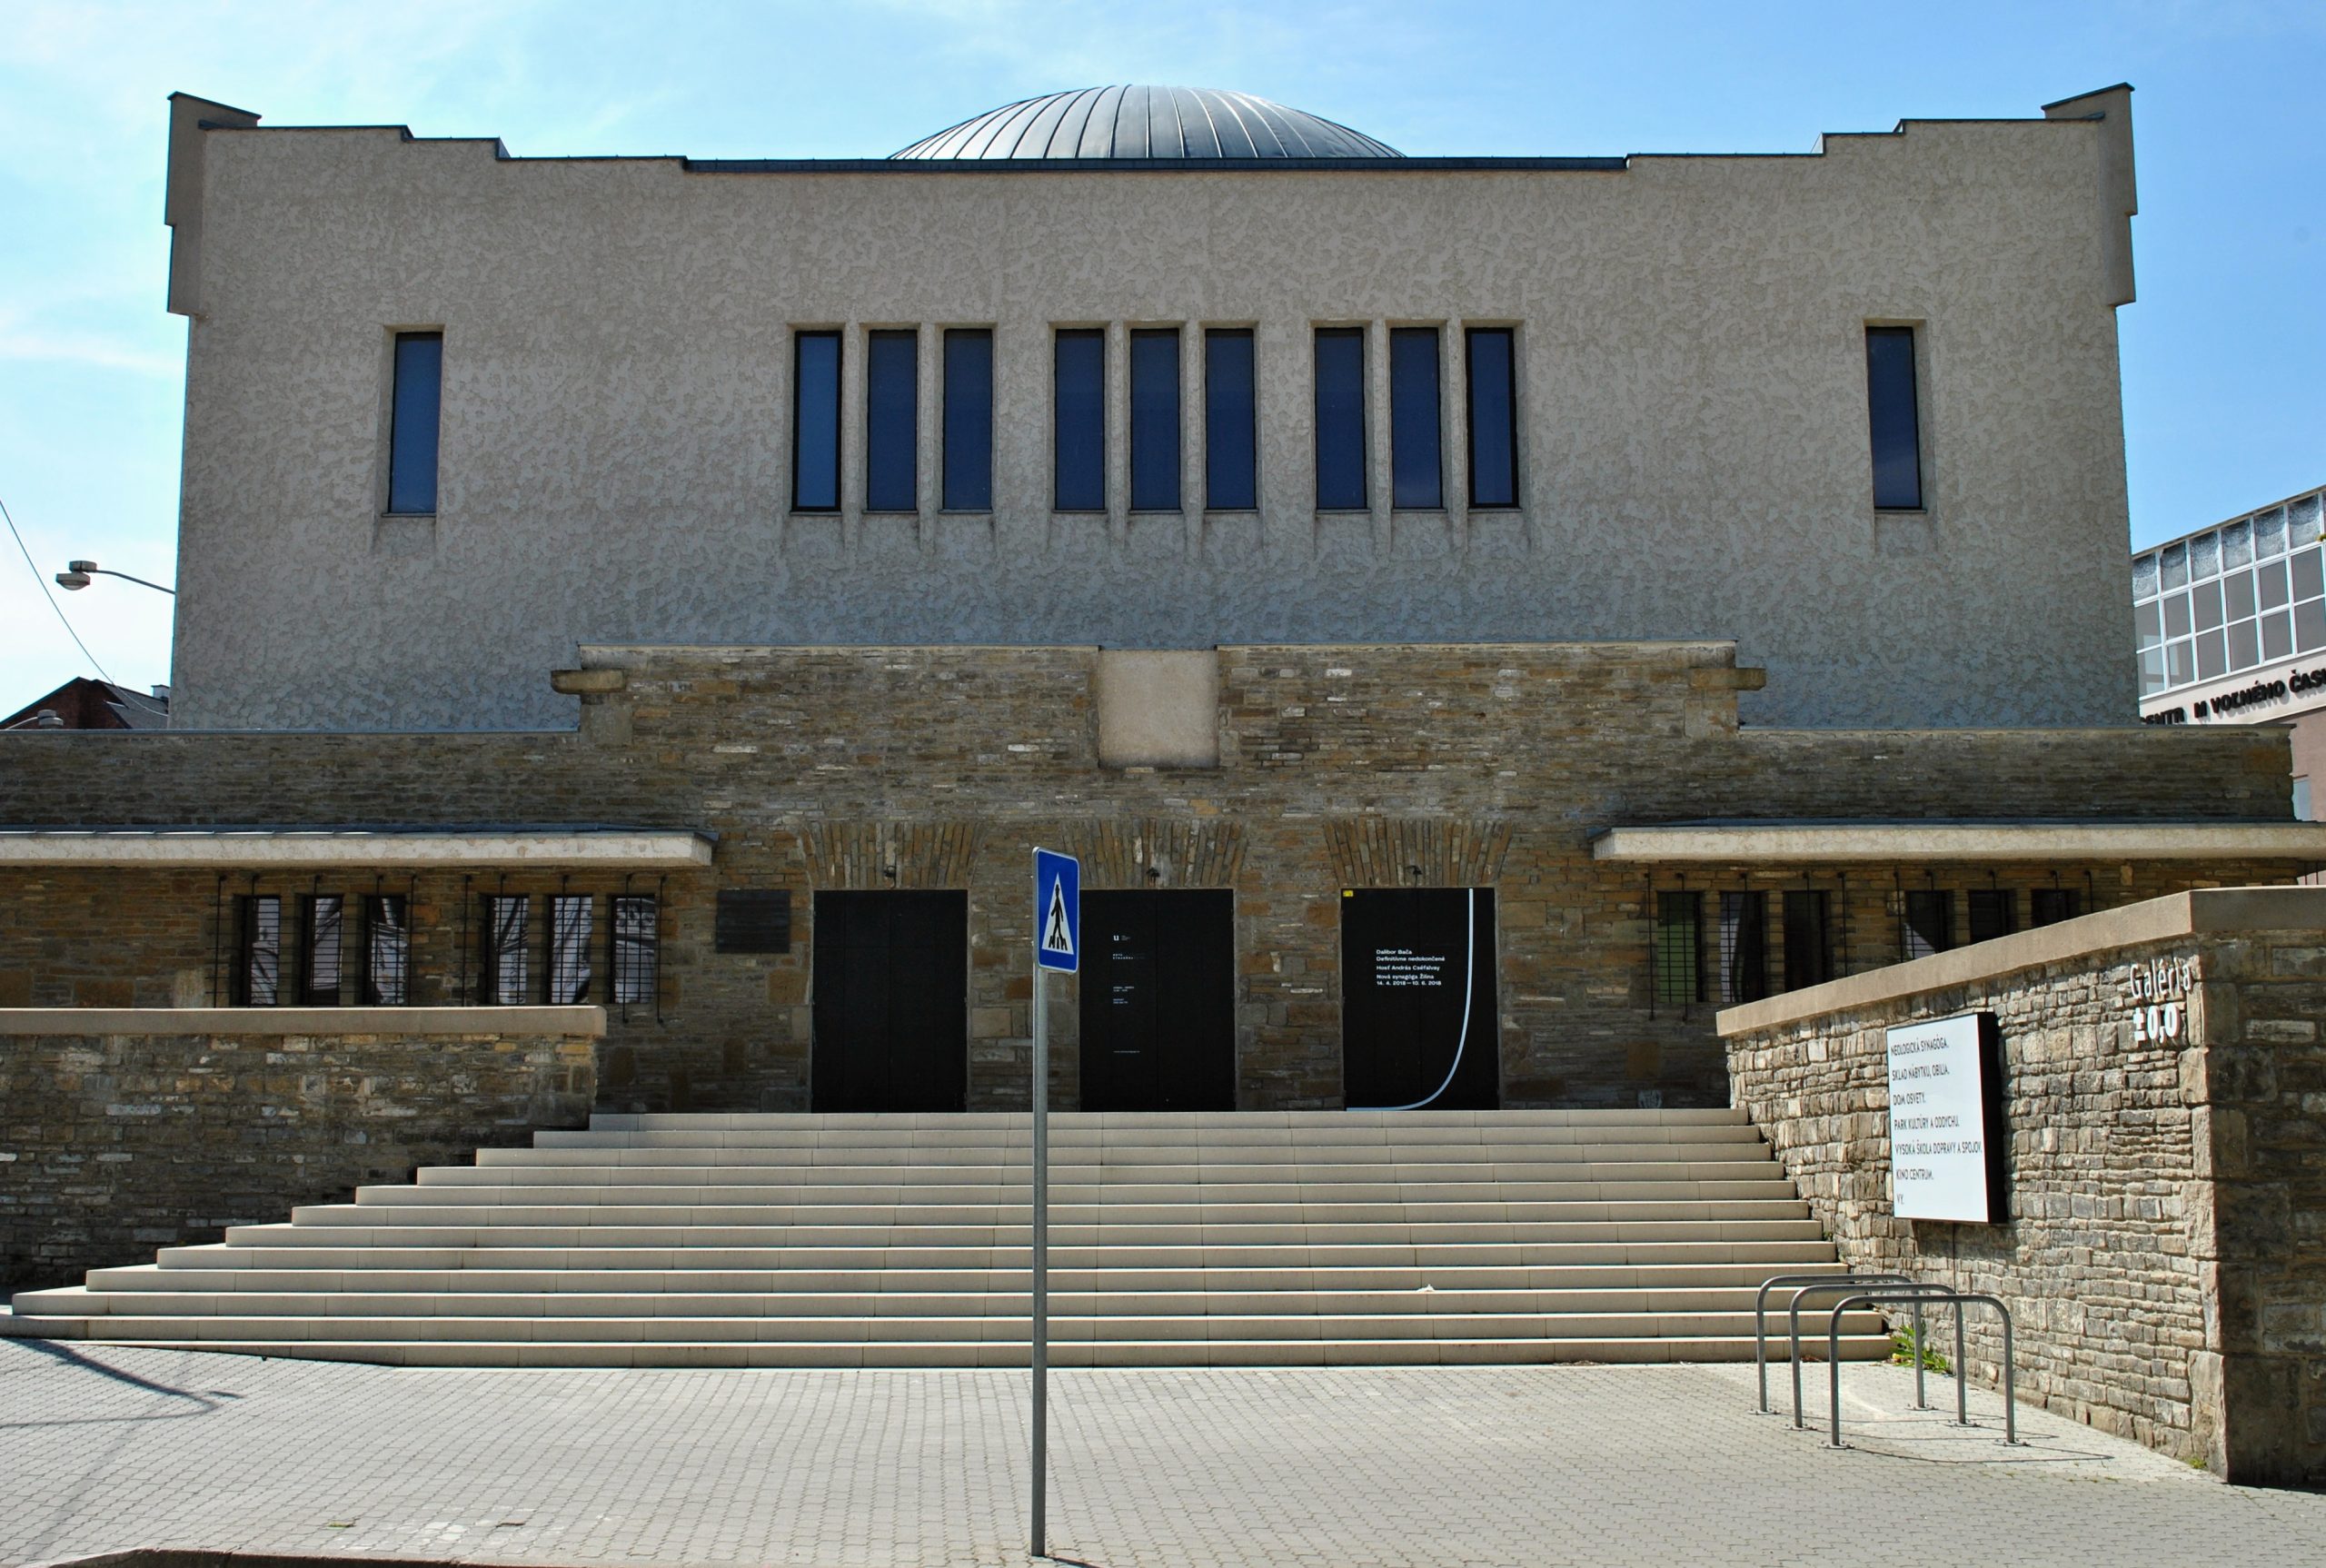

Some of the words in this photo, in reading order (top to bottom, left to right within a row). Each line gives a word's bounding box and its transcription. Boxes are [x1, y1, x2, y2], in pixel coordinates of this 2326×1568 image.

[2130, 957, 2191, 999] Galéria
[1890, 1037, 1920, 1056] NEOLOGICKÁ
[1892, 1067, 1908, 1081] SKLAD
[1893, 1093, 1906, 1106] DOM
[1894, 1118, 1907, 1130] PARK
[1908, 1114, 1929, 1130] KULTÚRY
[1930, 1117, 1934, 1127] A
[1894, 1139, 1916, 1156] VYSOKÁ
[1916, 1138, 1933, 1155] ŠKOLA
[1933, 1142, 1957, 1155] DOPRAVY
[1956, 1142, 1962, 1154] A
[1895, 1168, 1909, 1180] KINO
